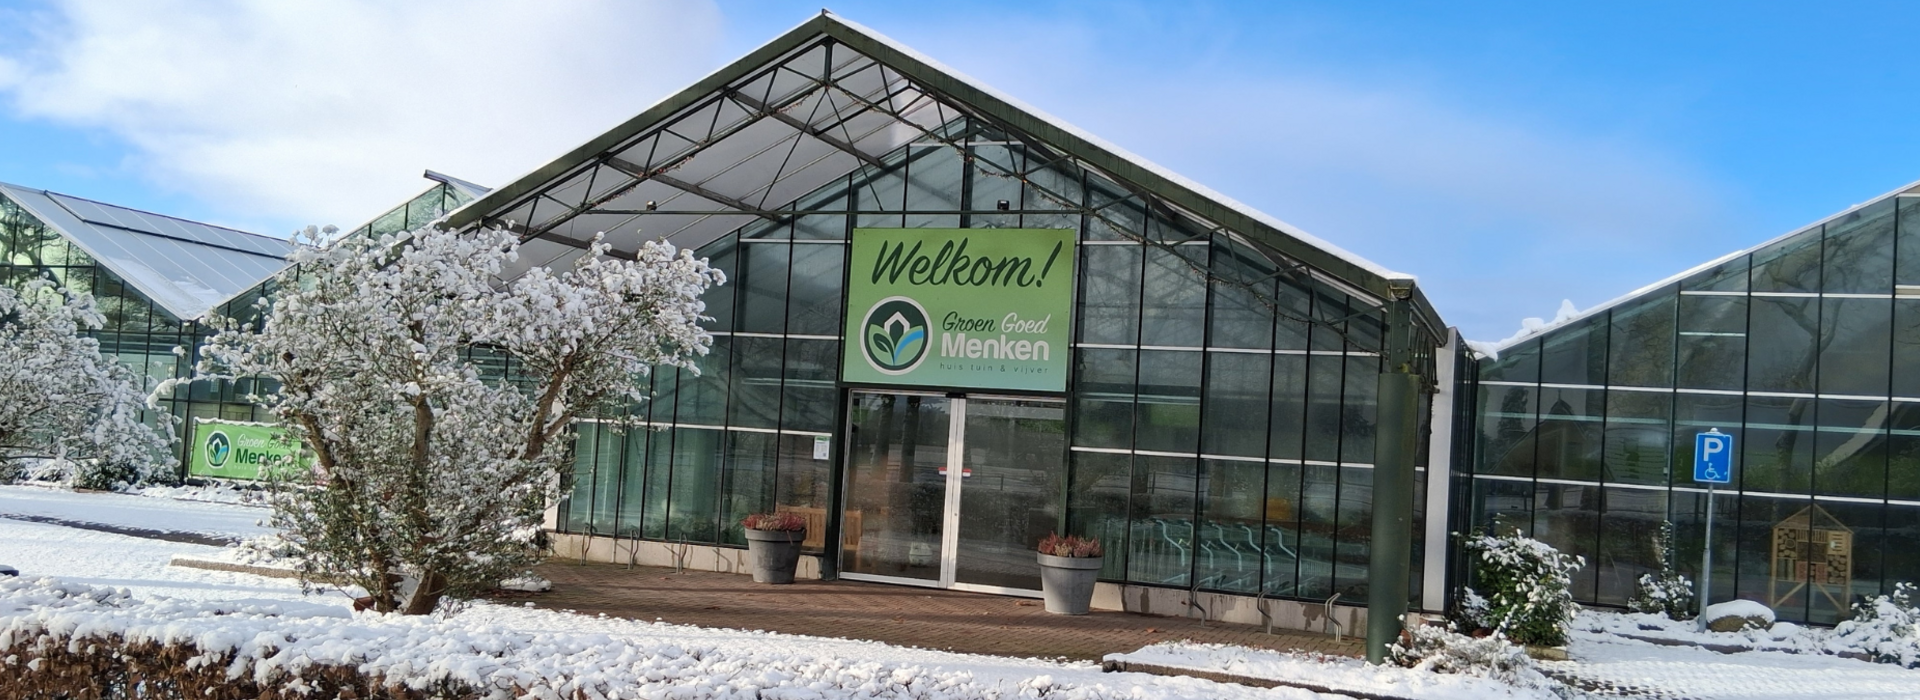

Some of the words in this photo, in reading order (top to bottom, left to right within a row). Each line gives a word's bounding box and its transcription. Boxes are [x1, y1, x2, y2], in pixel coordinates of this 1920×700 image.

[871, 237, 1063, 288] Welkom!
[942, 311, 996, 332] Groen
[1001, 312, 1051, 334] Goed
[941, 332, 1050, 361] Menken
[940, 362, 964, 371] huis
[970, 364, 993, 372] tuin
[1000, 365, 1006, 373] &
[1013, 366, 1049, 375] vijver
[237, 433, 265, 448] Groen
[1704, 438, 1723, 461] P
